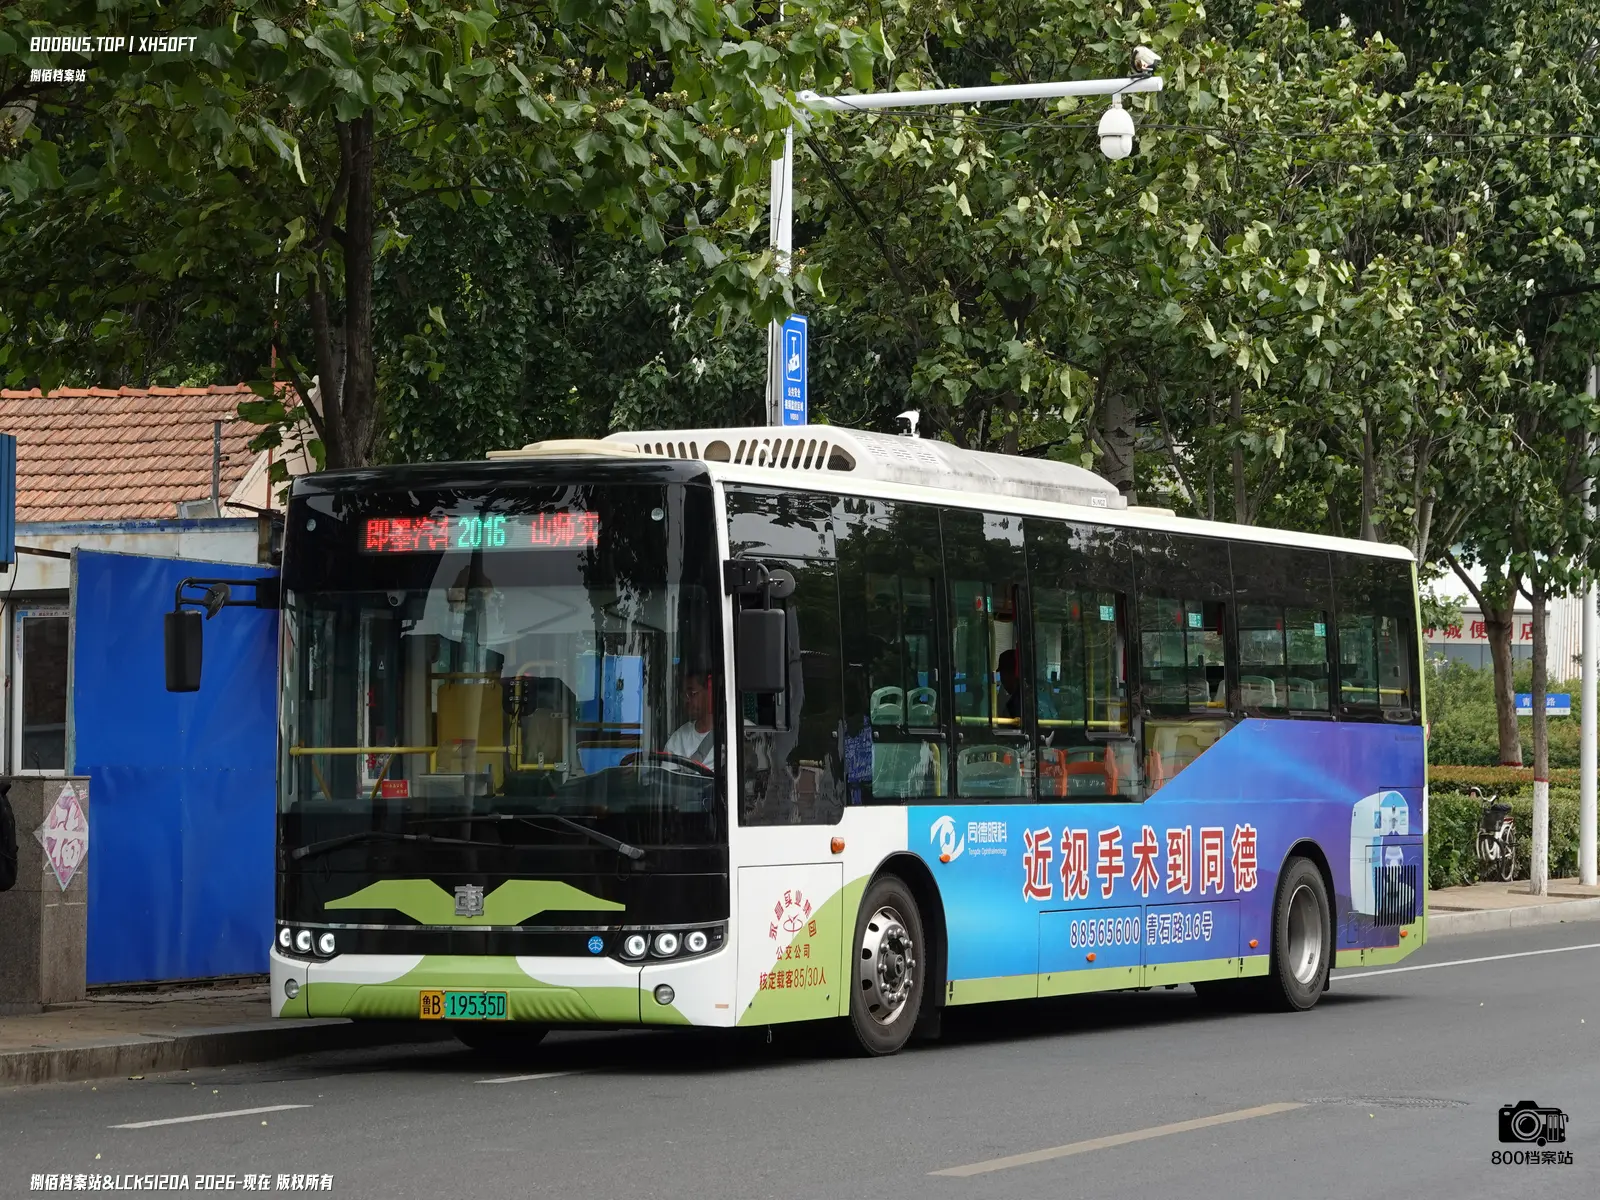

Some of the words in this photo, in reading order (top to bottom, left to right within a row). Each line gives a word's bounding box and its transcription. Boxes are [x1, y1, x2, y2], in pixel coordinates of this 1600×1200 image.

[457, 516, 507, 548] 2016
[531, 511, 599, 547] 山师实
[1422, 619, 1533, 640] 城便店
[967, 821, 1007, 844] 同德眼科
[1022, 823, 1259, 902] 近视手术到同德
[1070, 917, 1140, 948] 88565600
[1146, 911, 1213, 945] 青石路16号
[776, 943, 810, 960] 公交公司
[759, 965, 827, 991] 核定载客85/30人
[422, 995, 441, 1015] 鲁B
[450, 995, 506, 1016] 19535D
